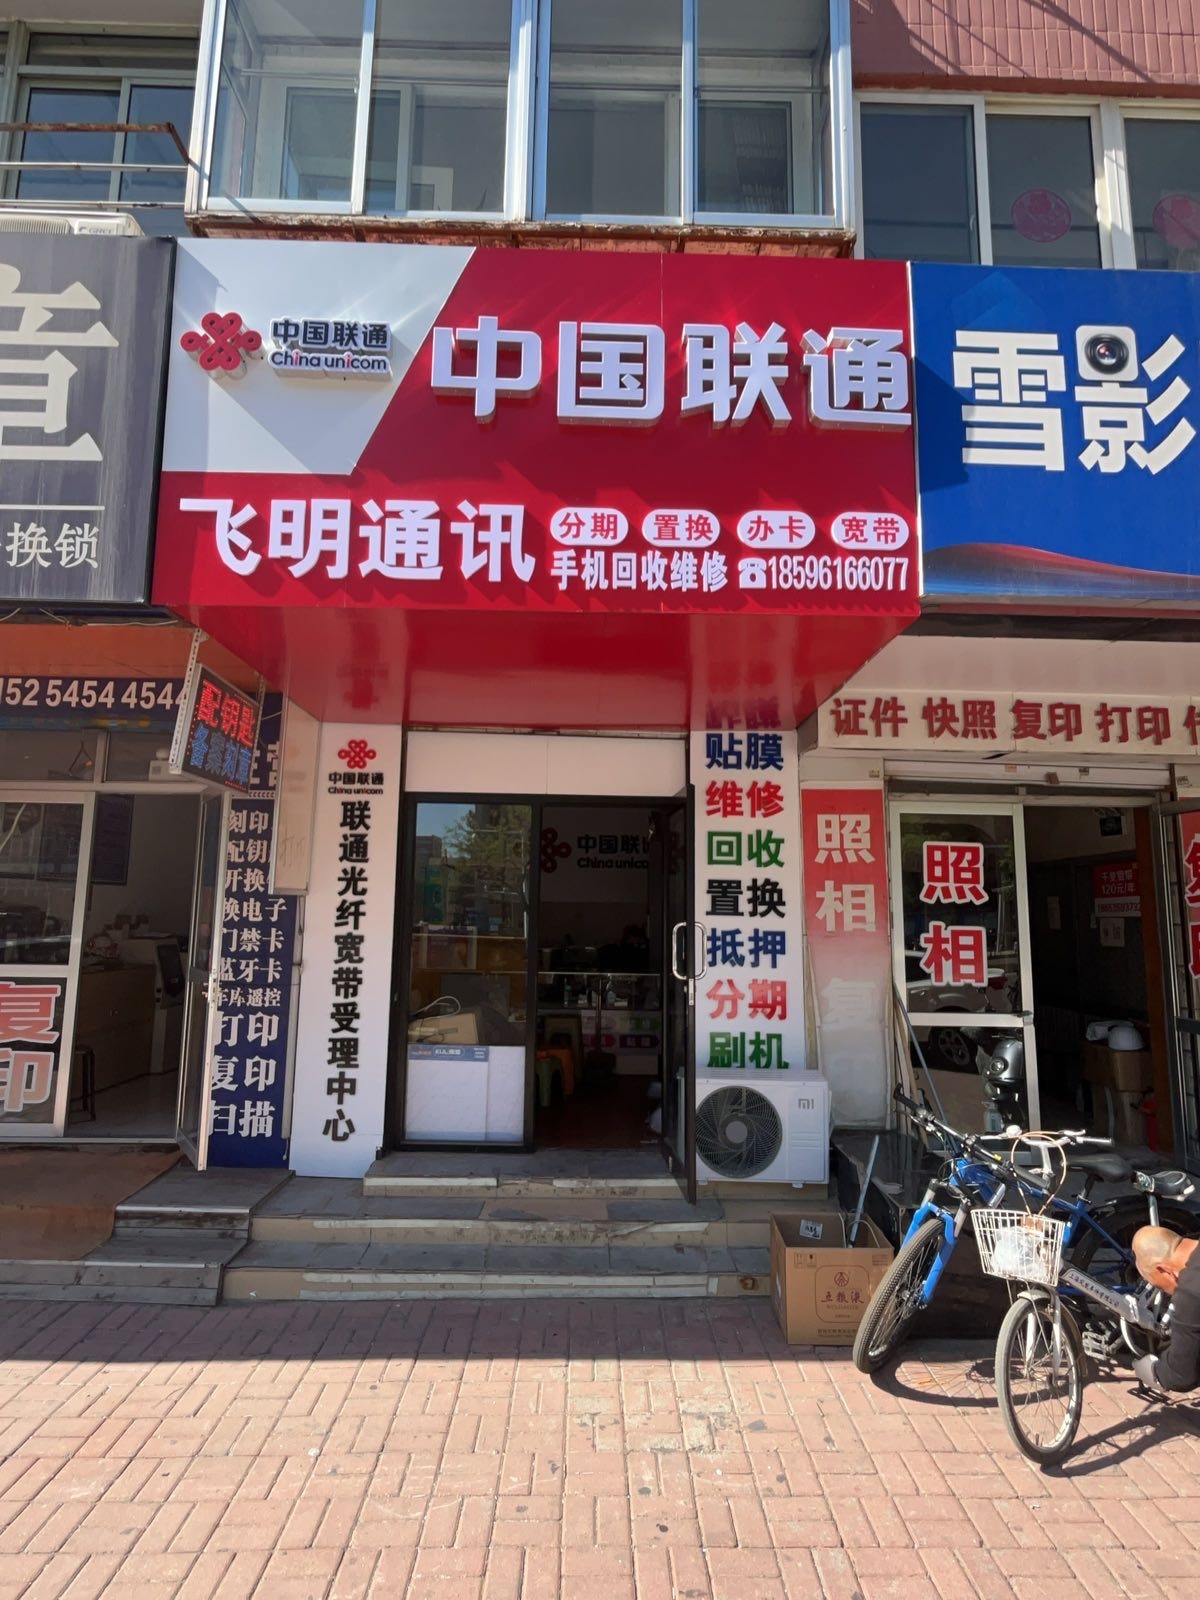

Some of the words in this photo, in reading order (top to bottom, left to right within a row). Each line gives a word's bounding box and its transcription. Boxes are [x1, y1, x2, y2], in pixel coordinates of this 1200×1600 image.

[272, 319, 388, 349] 中国联通
[271, 350, 321, 367] China
[324, 352, 387, 370] unicom
[430, 315, 912, 427] 中国联通
[952, 324, 1196, 475] 雪影
[0, 521, 99, 569] 换锁
[179, 497, 536, 583] 飞明通讯
[558, 512, 618, 541] 分期
[653, 513, 714, 542] 置换
[746, 515, 806, 543] 办卡
[841, 517, 900, 545] 宽带
[550, 549, 729, 593] 手机回收维修
[768, 555, 909, 592] 18596166077
[45, 679, 115, 709] 5454
[197, 680, 255, 747] 配钥匙
[830, 697, 908, 738] 证件
[922, 697, 998, 740] 快照
[1011, 699, 1083, 742] 复印
[1094, 702, 1172, 745] 打印
[705, 732, 785, 772] 贴膜
[328, 771, 384, 785] 中国联通
[353, 787, 384, 795] unicom
[704, 779, 785, 818] 维修
[228, 809, 273, 834] 刻印
[227, 839, 272, 864] 配钥
[706, 829, 785, 869] 回收
[225, 868, 272, 893] 开换
[705, 878, 787, 919] 置换
[920, 841, 988, 988] 照相
[221, 927, 285, 953] 门禁卡
[706, 928, 787, 970] 抵押
[322, 801, 371, 1143] 联通光纤宽带受理中心
[706, 979, 788, 1021] 分期
[214, 1011, 279, 1047] 打印
[707, 1031, 789, 1070] 刷机
[212, 1054, 277, 1092] 复印
[209, 1100, 275, 1138] 扫描
